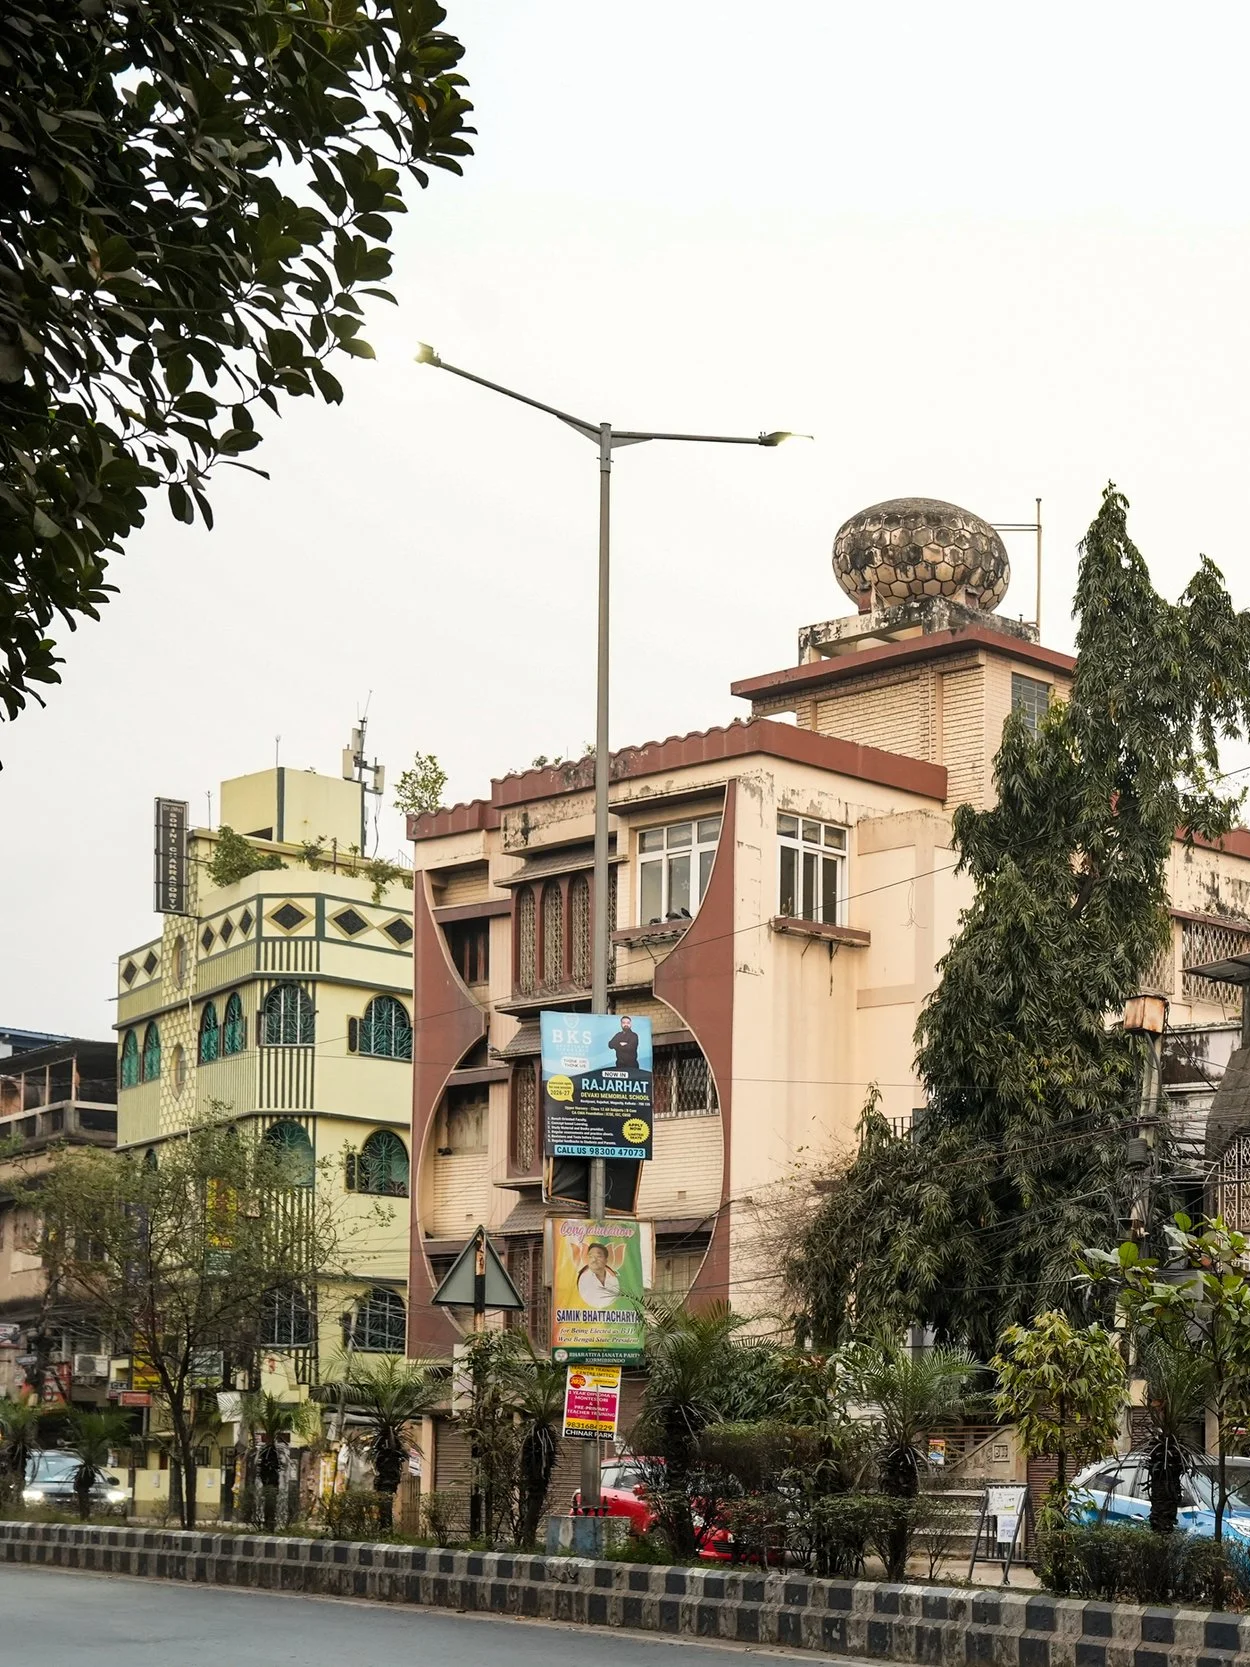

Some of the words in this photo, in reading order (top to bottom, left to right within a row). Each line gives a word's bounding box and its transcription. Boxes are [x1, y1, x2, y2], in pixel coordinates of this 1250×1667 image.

[551, 1029, 592, 1045] BKS
[581, 1078, 649, 1093] RAJARHAT
[556, 1146, 576, 1154] CALL
[589, 1148, 616, 1156] 98300
[618, 1149, 644, 1157] 47073
[556, 1309, 580, 1322] SAMIK
[582, 1310, 641, 1323] BHATTACHARYA
[565, 1429, 593, 1437] CHINAR
[594, 1431, 613, 1439] PARK
